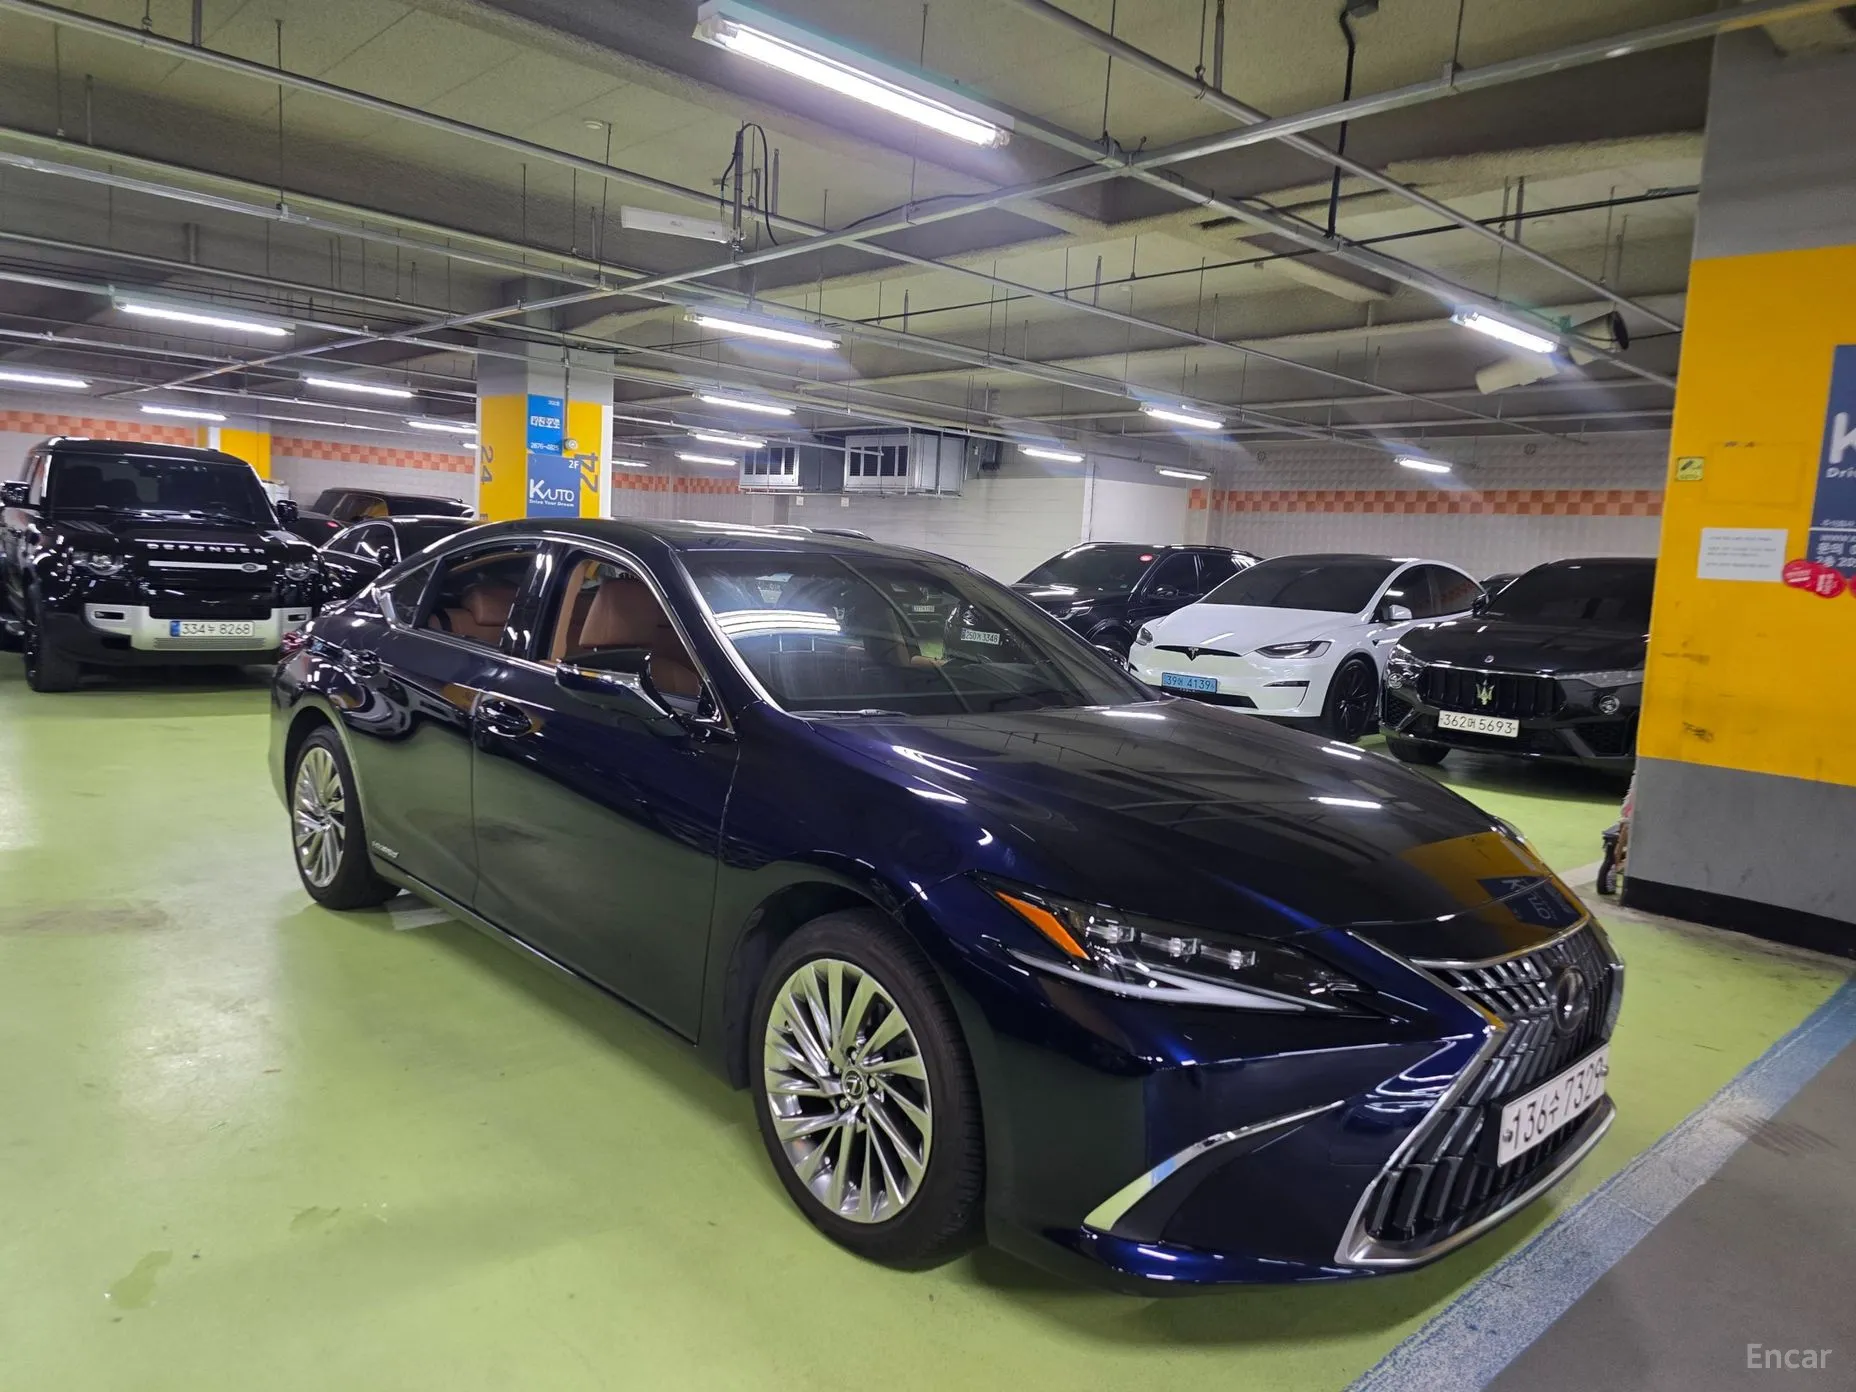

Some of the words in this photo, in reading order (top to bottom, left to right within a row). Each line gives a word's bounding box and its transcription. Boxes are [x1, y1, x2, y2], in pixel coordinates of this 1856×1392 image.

[568, 460, 580, 469] 2F
[146, 543, 265, 554] DEFENDER
[219, 623, 250, 635] 8268
[1187, 679, 1211, 690] 4139
[1479, 718, 1513, 734] 5693
[1511, 1089, 1560, 1150] 136수
[1564, 1056, 1605, 1117] 7329
